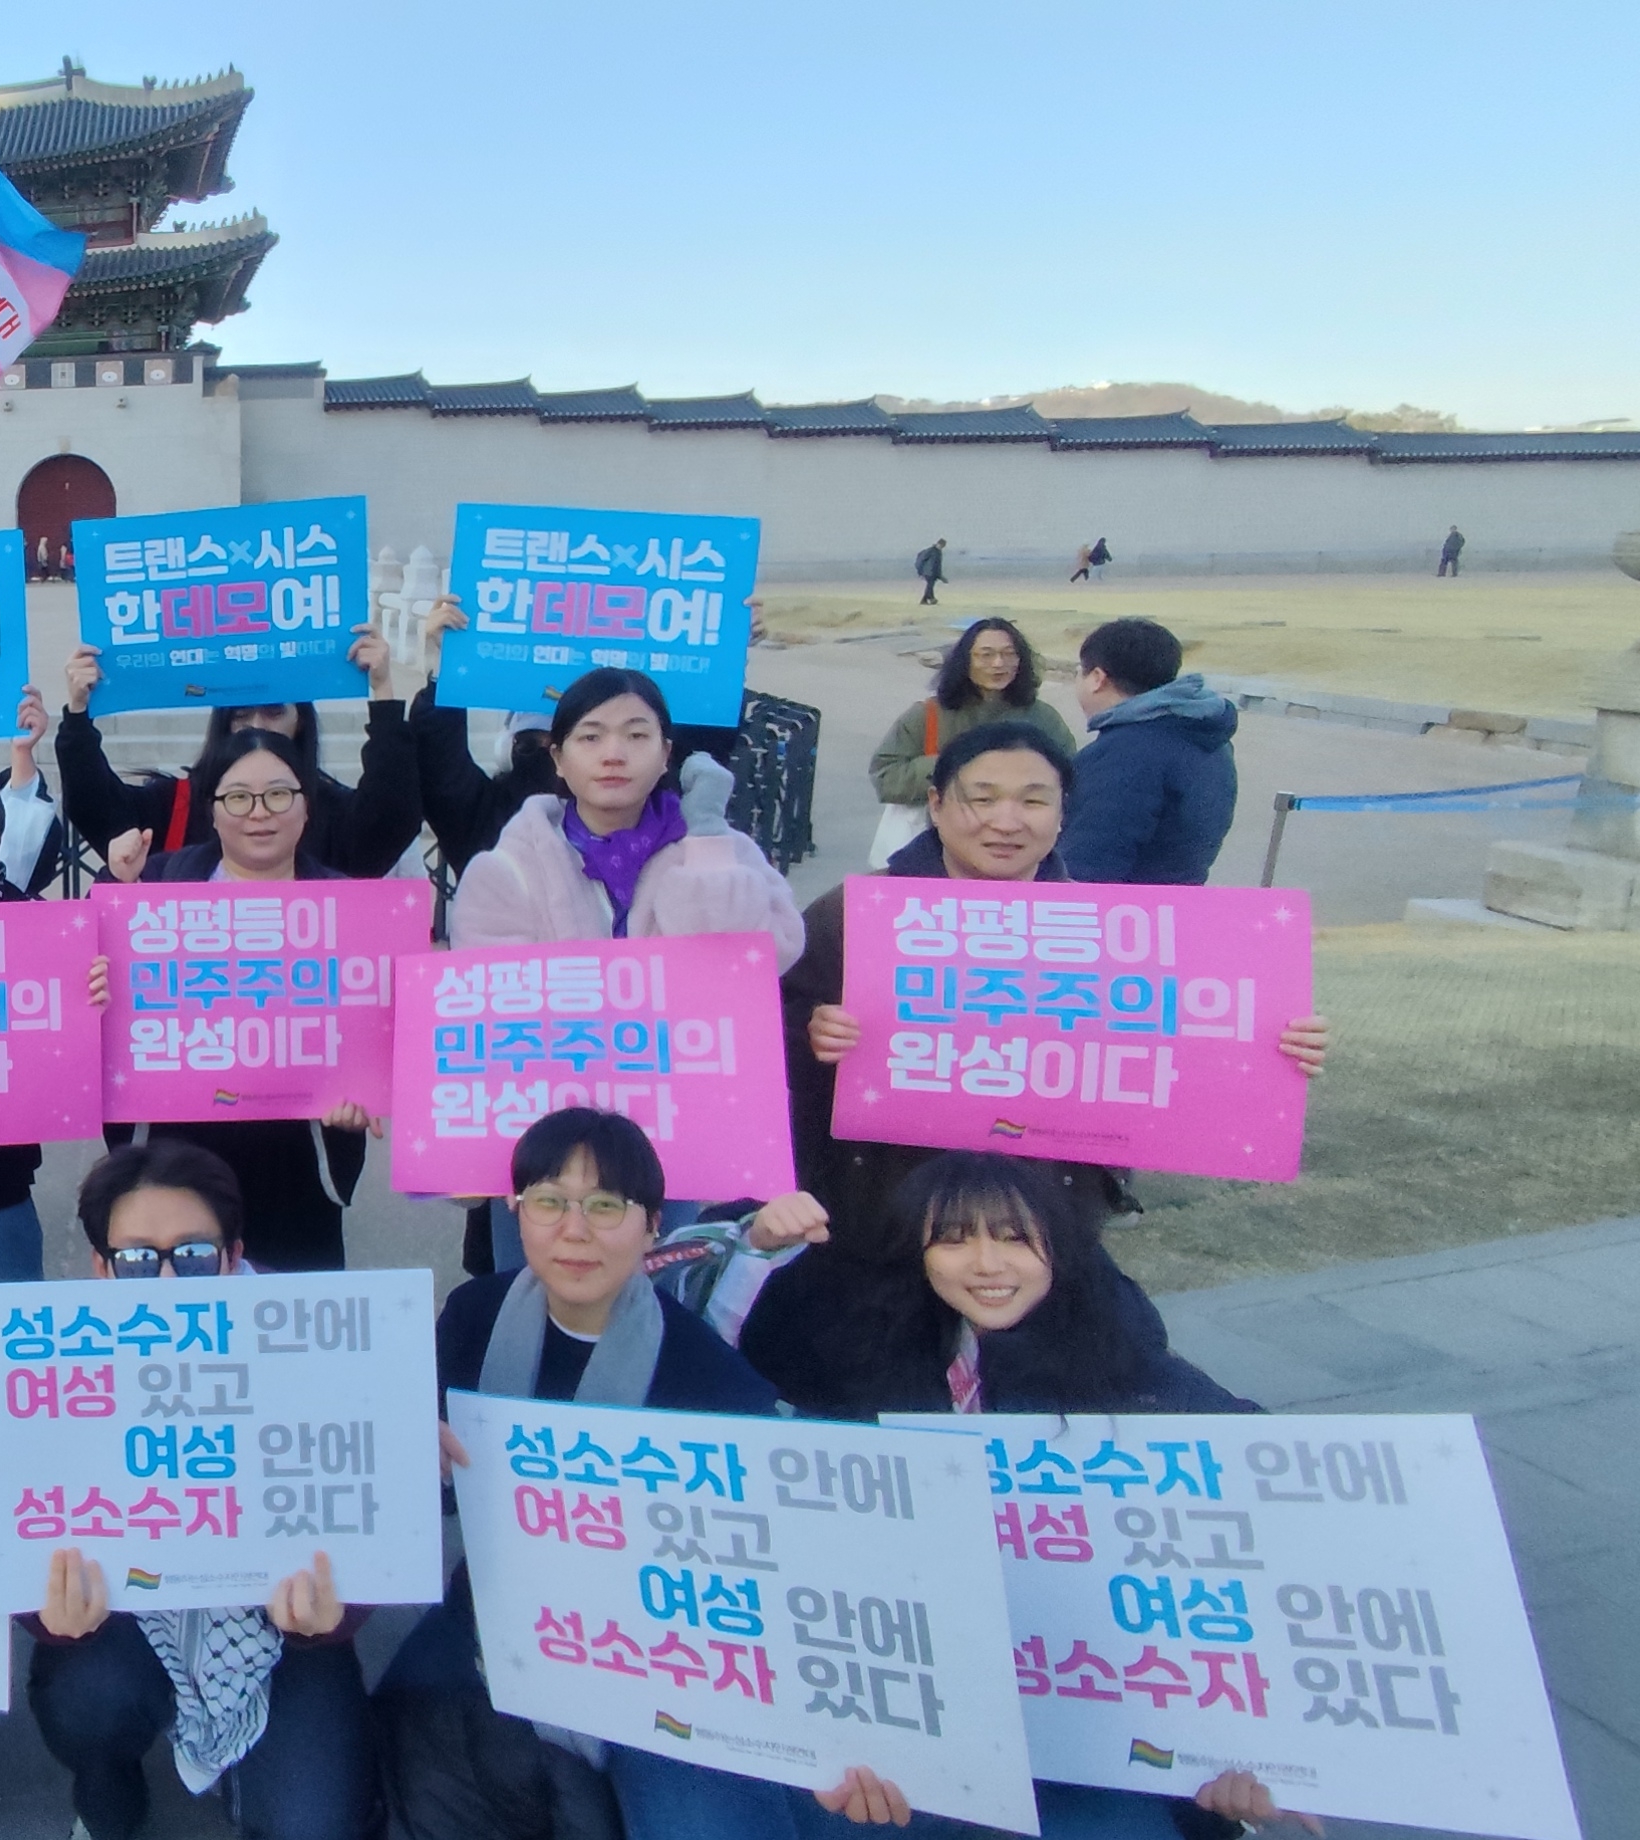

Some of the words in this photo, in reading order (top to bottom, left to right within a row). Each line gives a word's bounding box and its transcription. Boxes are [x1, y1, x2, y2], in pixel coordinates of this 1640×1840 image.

[104, 574, 341, 647] 한데모여!
[475, 575, 722, 647] 한데모여!
[116, 652, 165, 669] 우리의
[169, 648, 219, 667] 연대는
[224, 643, 275, 662] 혁명의
[476, 643, 529, 664] 우리의
[533, 645, 586, 666] 연대는
[591, 648, 646, 669] 혁명의
[128, 896, 337, 954] 성평등이
[893, 896, 1176, 967] 성평등이
[129, 954, 391, 1012] 민주주의의
[433, 954, 667, 1018] 성평등이
[893, 964, 1256, 1042] 민주주의의
[129, 1014, 343, 1072] 완성이다
[433, 1016, 736, 1076] 민주주의의
[886, 1030, 1179, 1109] 완성이다
[1, 1301, 234, 1360] 성소수자
[253, 1297, 371, 1354] 안에
[6, 1364, 117, 1419] 여성
[137, 1362, 254, 1418] 있고
[124, 1423, 237, 1479] 여성
[258, 1420, 376, 1478] 안에
[505, 1424, 747, 1502] 성소수자
[767, 1447, 915, 1521] 안에
[1244, 1440, 1409, 1505] 안에
[13, 1485, 243, 1541] 성소수자
[263, 1482, 380, 1539] 있다
[515, 1484, 627, 1552] 여성
[646, 1502, 779, 1572] 있고
[1114, 1506, 1264, 1571] 있고
[639, 1564, 766, 1638] 여성
[785, 1585, 936, 1667] 안에
[1108, 1573, 1254, 1643] 여성
[1275, 1583, 1446, 1658] 안에
[533, 1605, 777, 1706] 성소수자
[796, 1654, 945, 1738] 있다
[1292, 1656, 1461, 1736] 있다
